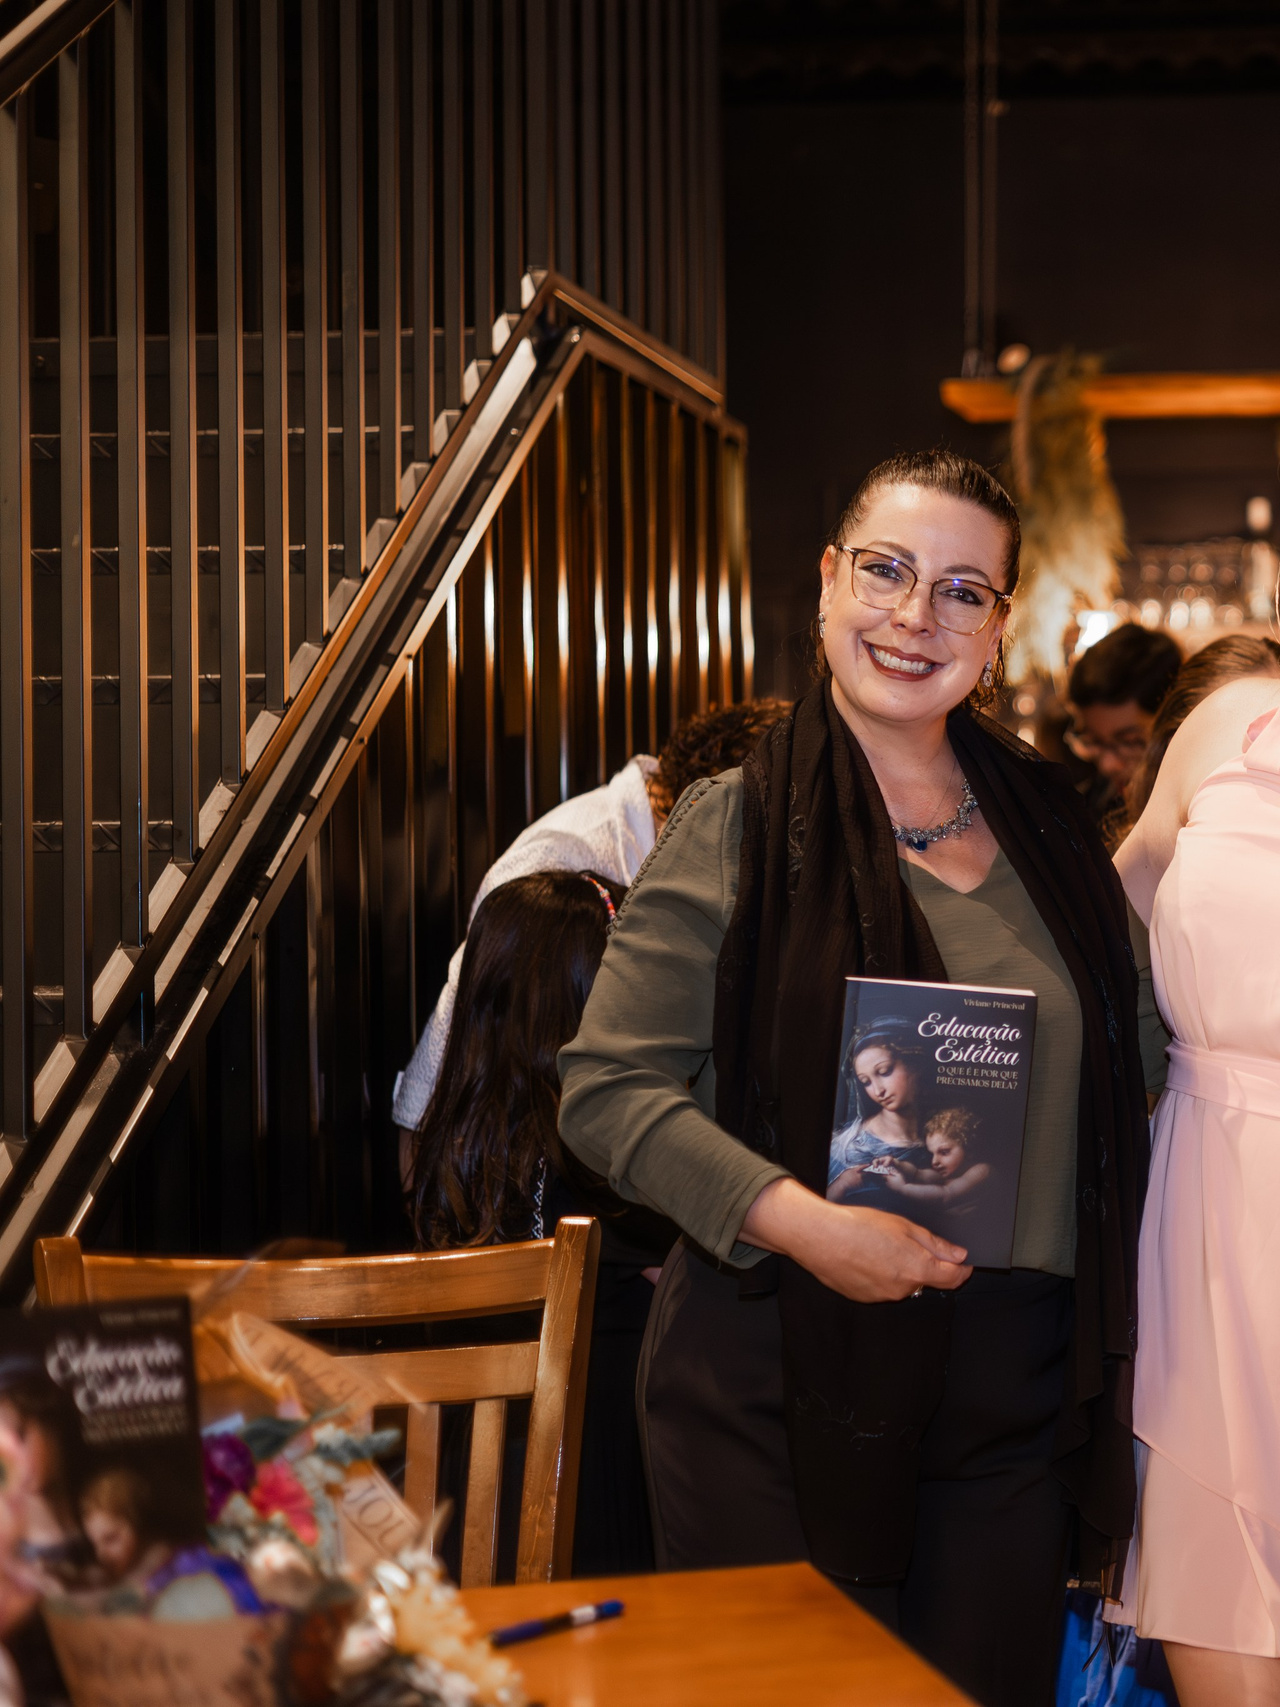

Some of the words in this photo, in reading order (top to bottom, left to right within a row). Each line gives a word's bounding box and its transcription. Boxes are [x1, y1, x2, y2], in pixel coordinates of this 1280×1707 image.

[963, 998, 992, 1008] Viviane
[917, 1012, 1023, 1046] Educação
[934, 1038, 1020, 1066] Estética
[937, 1065, 946, 1074] O
[946, 1066, 966, 1076] QUE
[973, 1068, 980, 1077] E
[980, 1069, 999, 1079] POR
[999, 1070, 1019, 1080] QUE
[936, 1076, 990, 1088] PRECISAMOS
[990, 1080, 1018, 1090] DELA?
